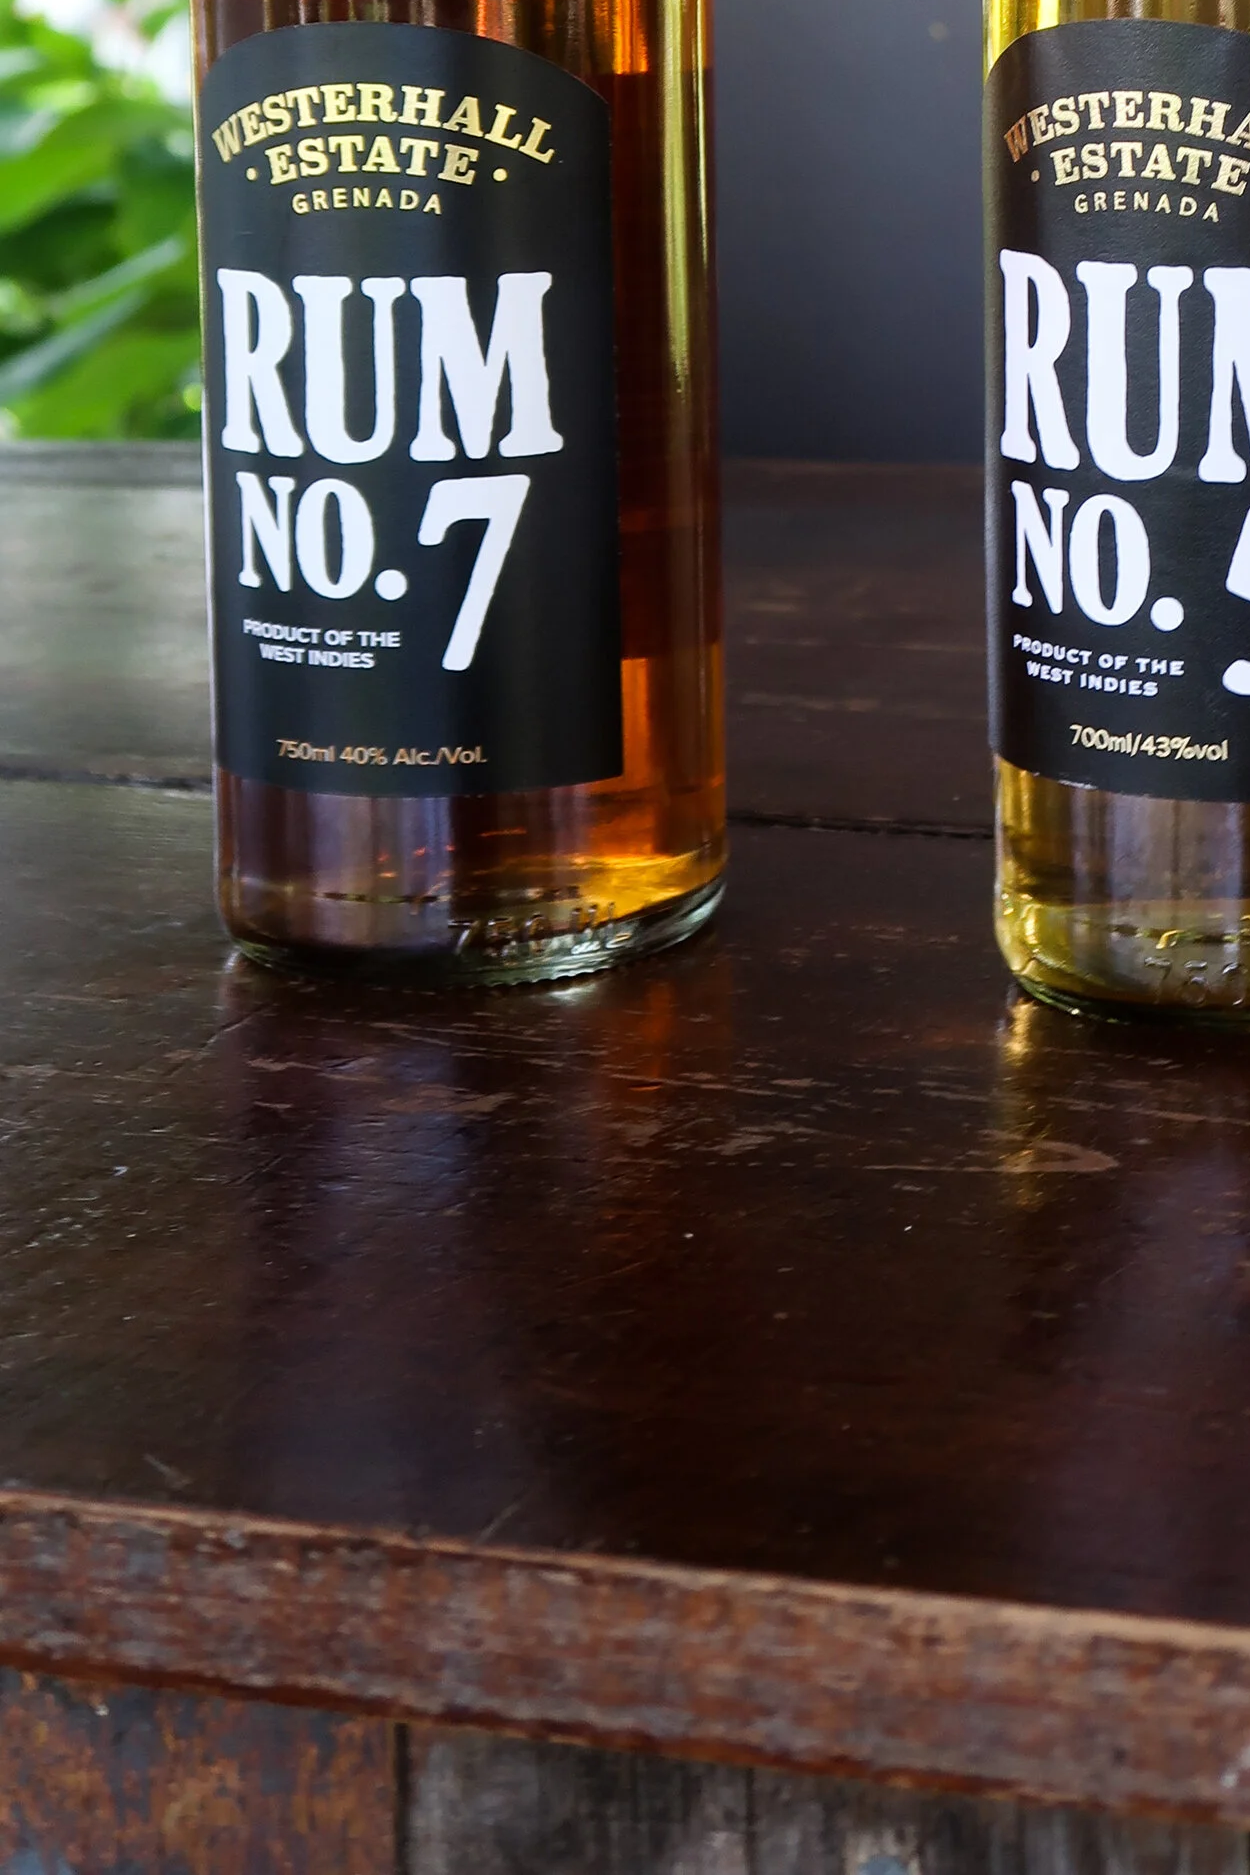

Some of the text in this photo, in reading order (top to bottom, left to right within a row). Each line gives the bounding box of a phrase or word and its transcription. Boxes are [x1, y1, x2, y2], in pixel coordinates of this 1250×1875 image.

[211, 82, 555, 164] WESTERHALL
[265, 134, 479, 185] ESTATE
[291, 187, 443, 215] GRENADA
[1074, 190, 1220, 223] GRENADA
[216, 268, 564, 464] RUM
[236, 471, 532, 672] NO. 7
[1010, 479, 1185, 633] NO.
[243, 618, 401, 648] PRODUCT OF THE
[258, 643, 376, 669] WEST INDIES
[1012, 633, 1186, 676] PRODUCT OF THE
[1026, 660, 1160, 697] WEST INDIES
[275, 738, 336, 763] 750ml
[339, 745, 389, 766] 40%
